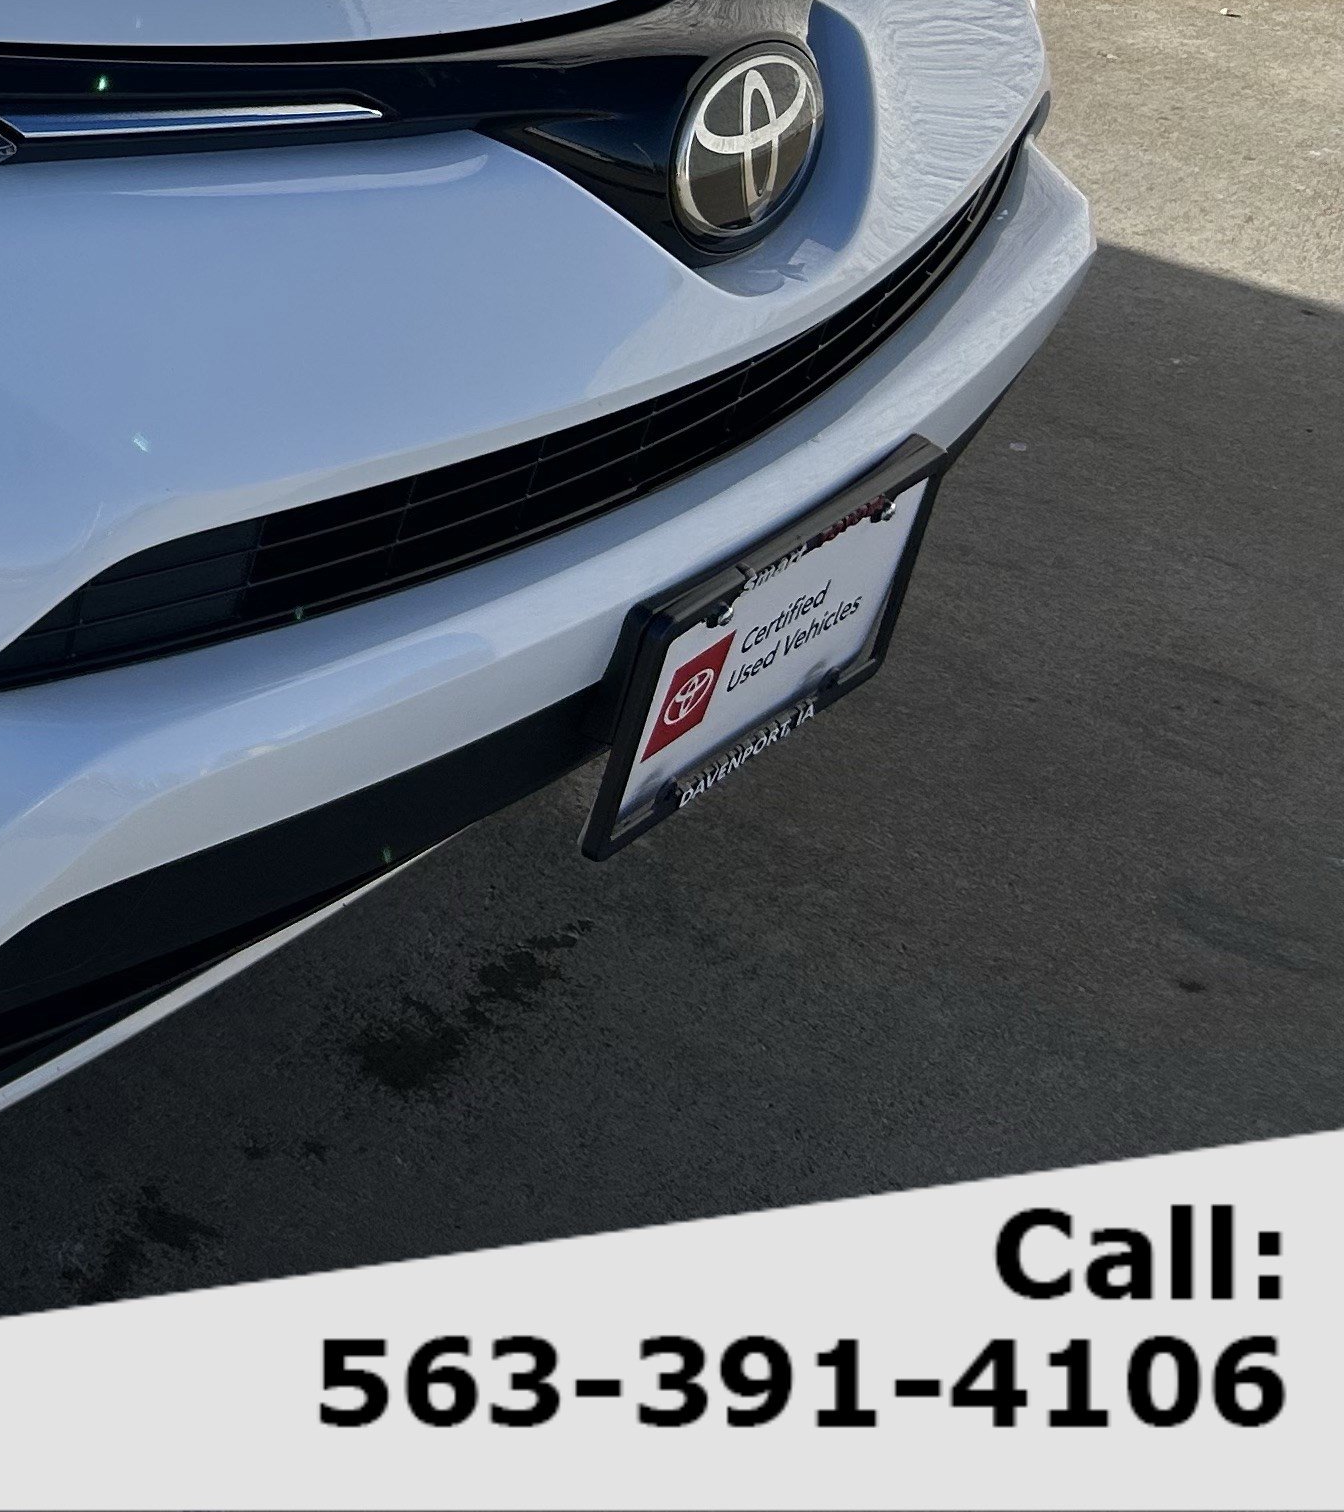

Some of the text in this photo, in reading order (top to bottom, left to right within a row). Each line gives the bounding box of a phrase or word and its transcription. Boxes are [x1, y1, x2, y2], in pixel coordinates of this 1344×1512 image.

[726, 595, 863, 693] Used Vehicles
[741, 578, 832, 654] Certified
[796, 703, 815, 727] IA
